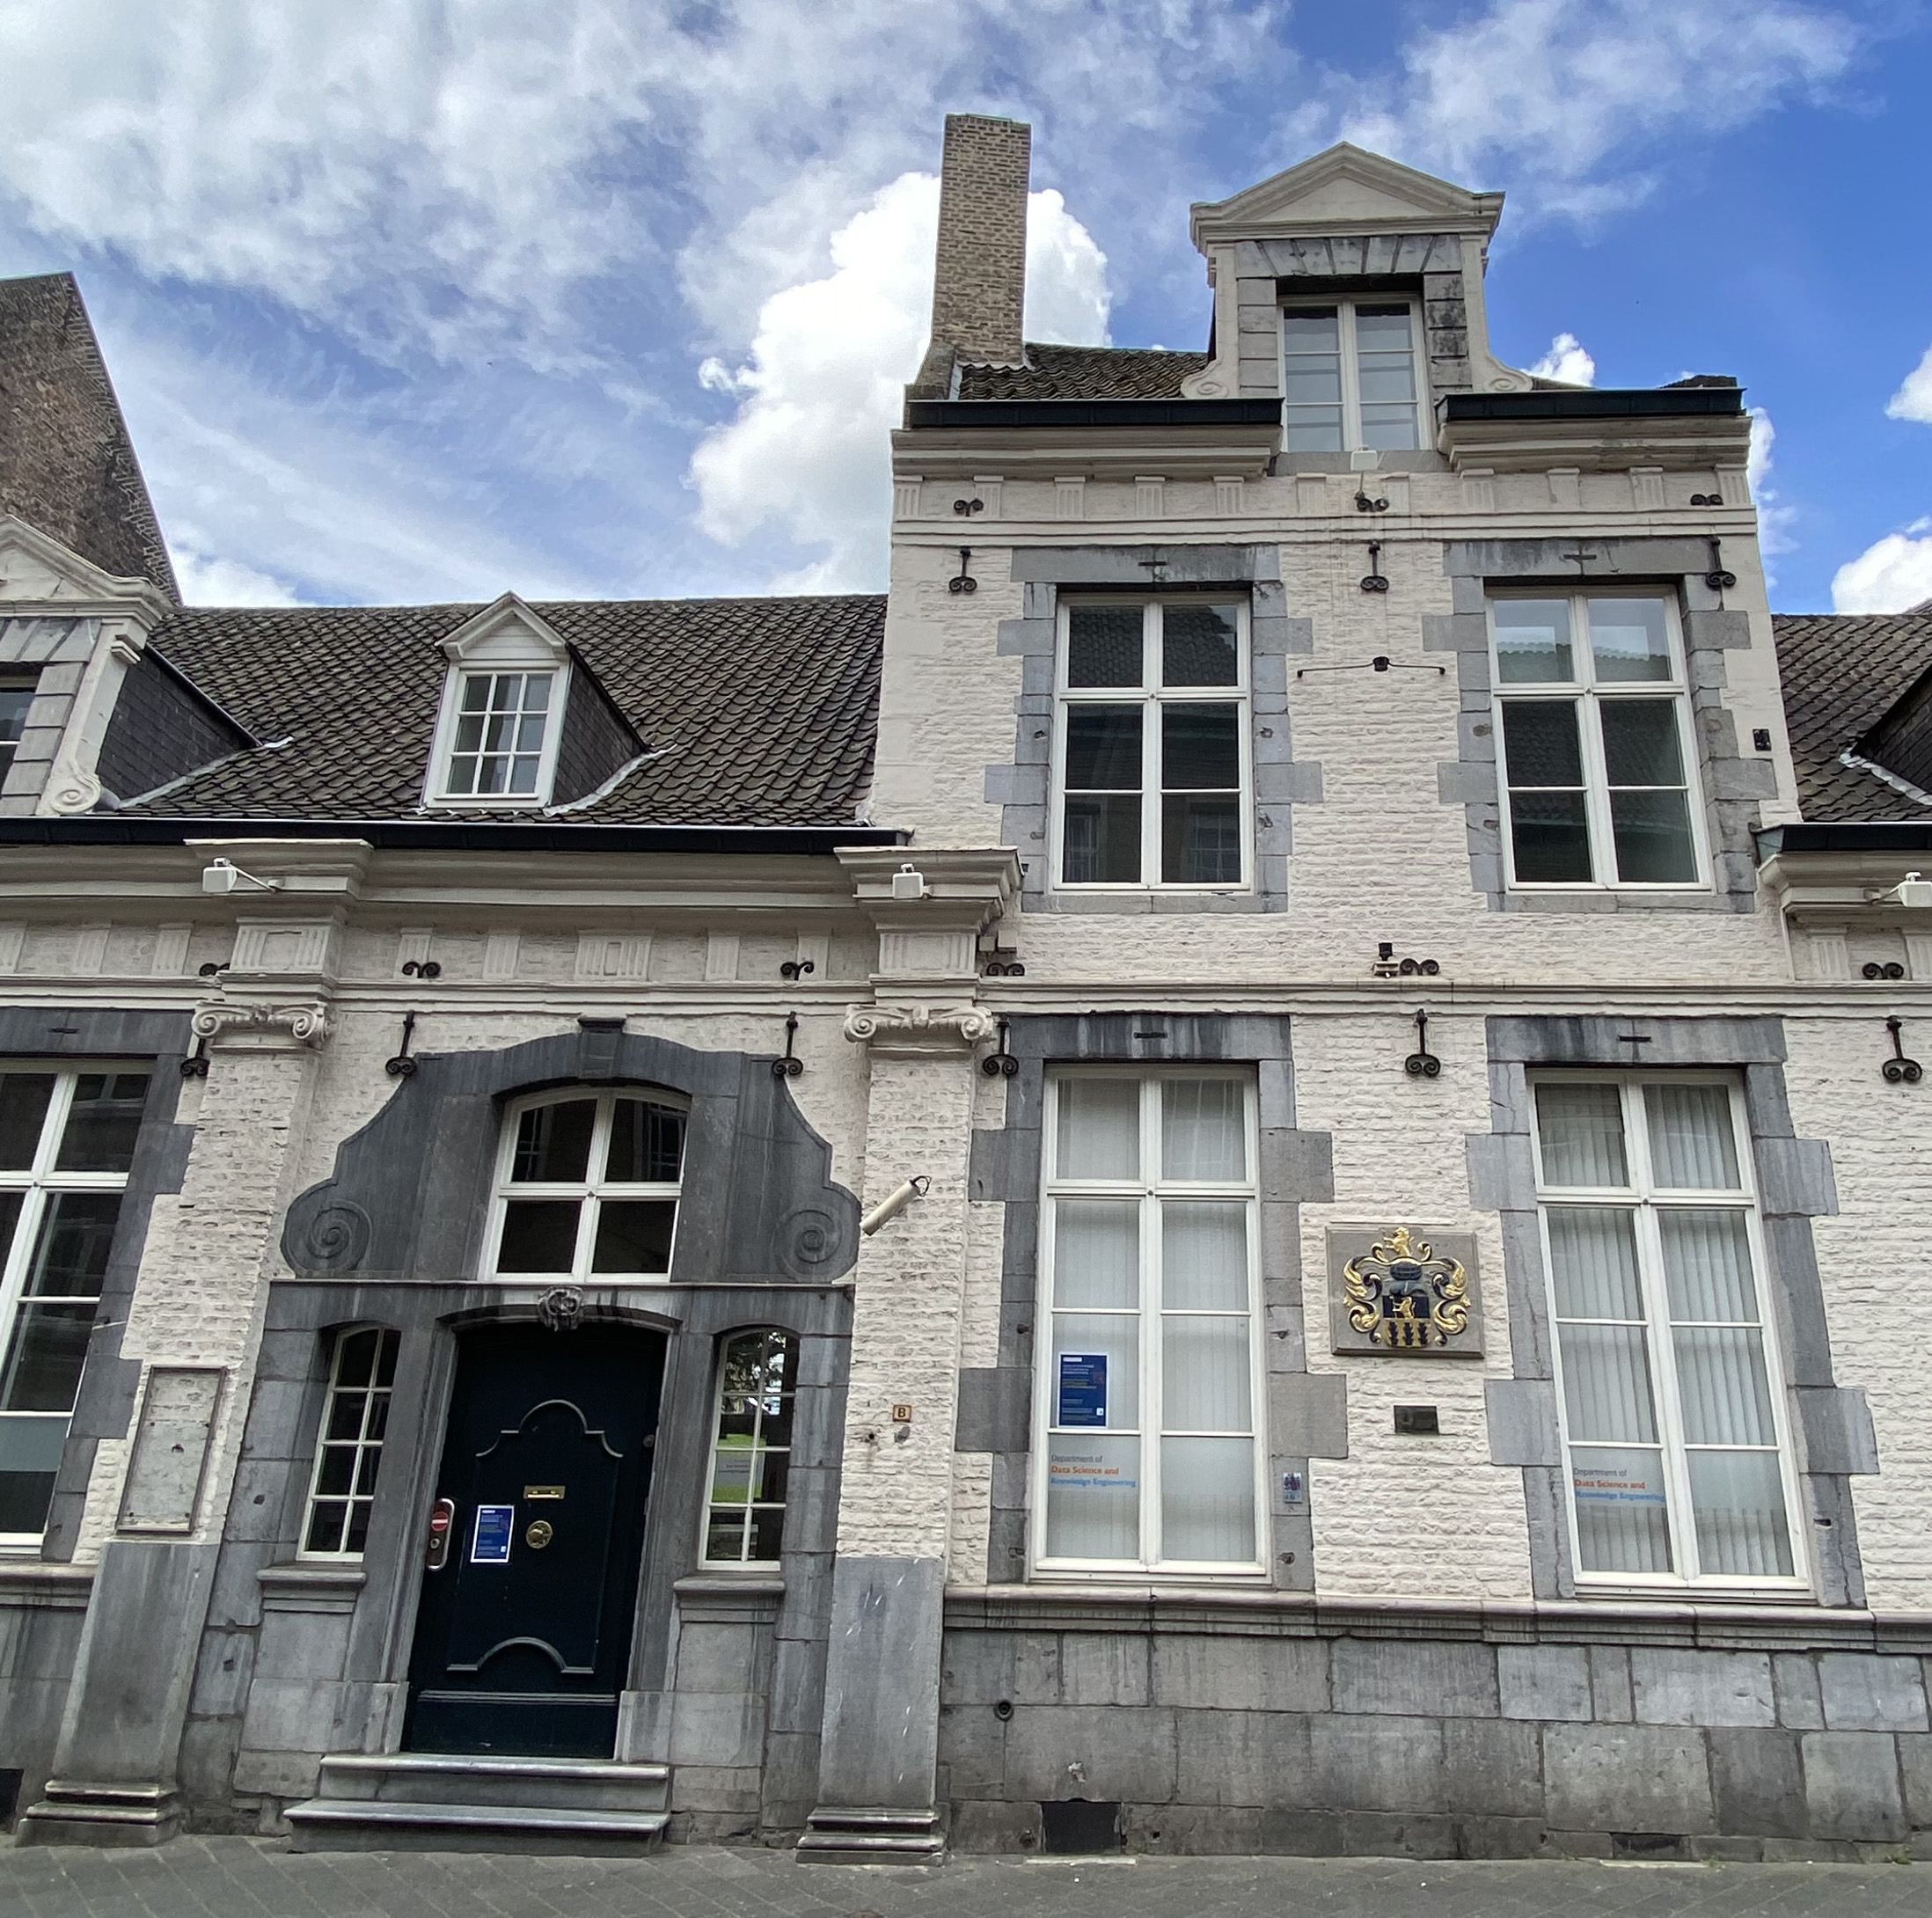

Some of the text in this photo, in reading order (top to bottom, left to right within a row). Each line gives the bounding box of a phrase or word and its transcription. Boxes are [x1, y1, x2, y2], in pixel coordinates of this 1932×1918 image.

[897, 1407, 906, 1417] B
[1050, 1454, 1094, 1463] Department
[1072, 1466, 1102, 1475] Science
[1573, 1468, 1618, 1476] Department
[1597, 1480, 1628, 1489] Science
